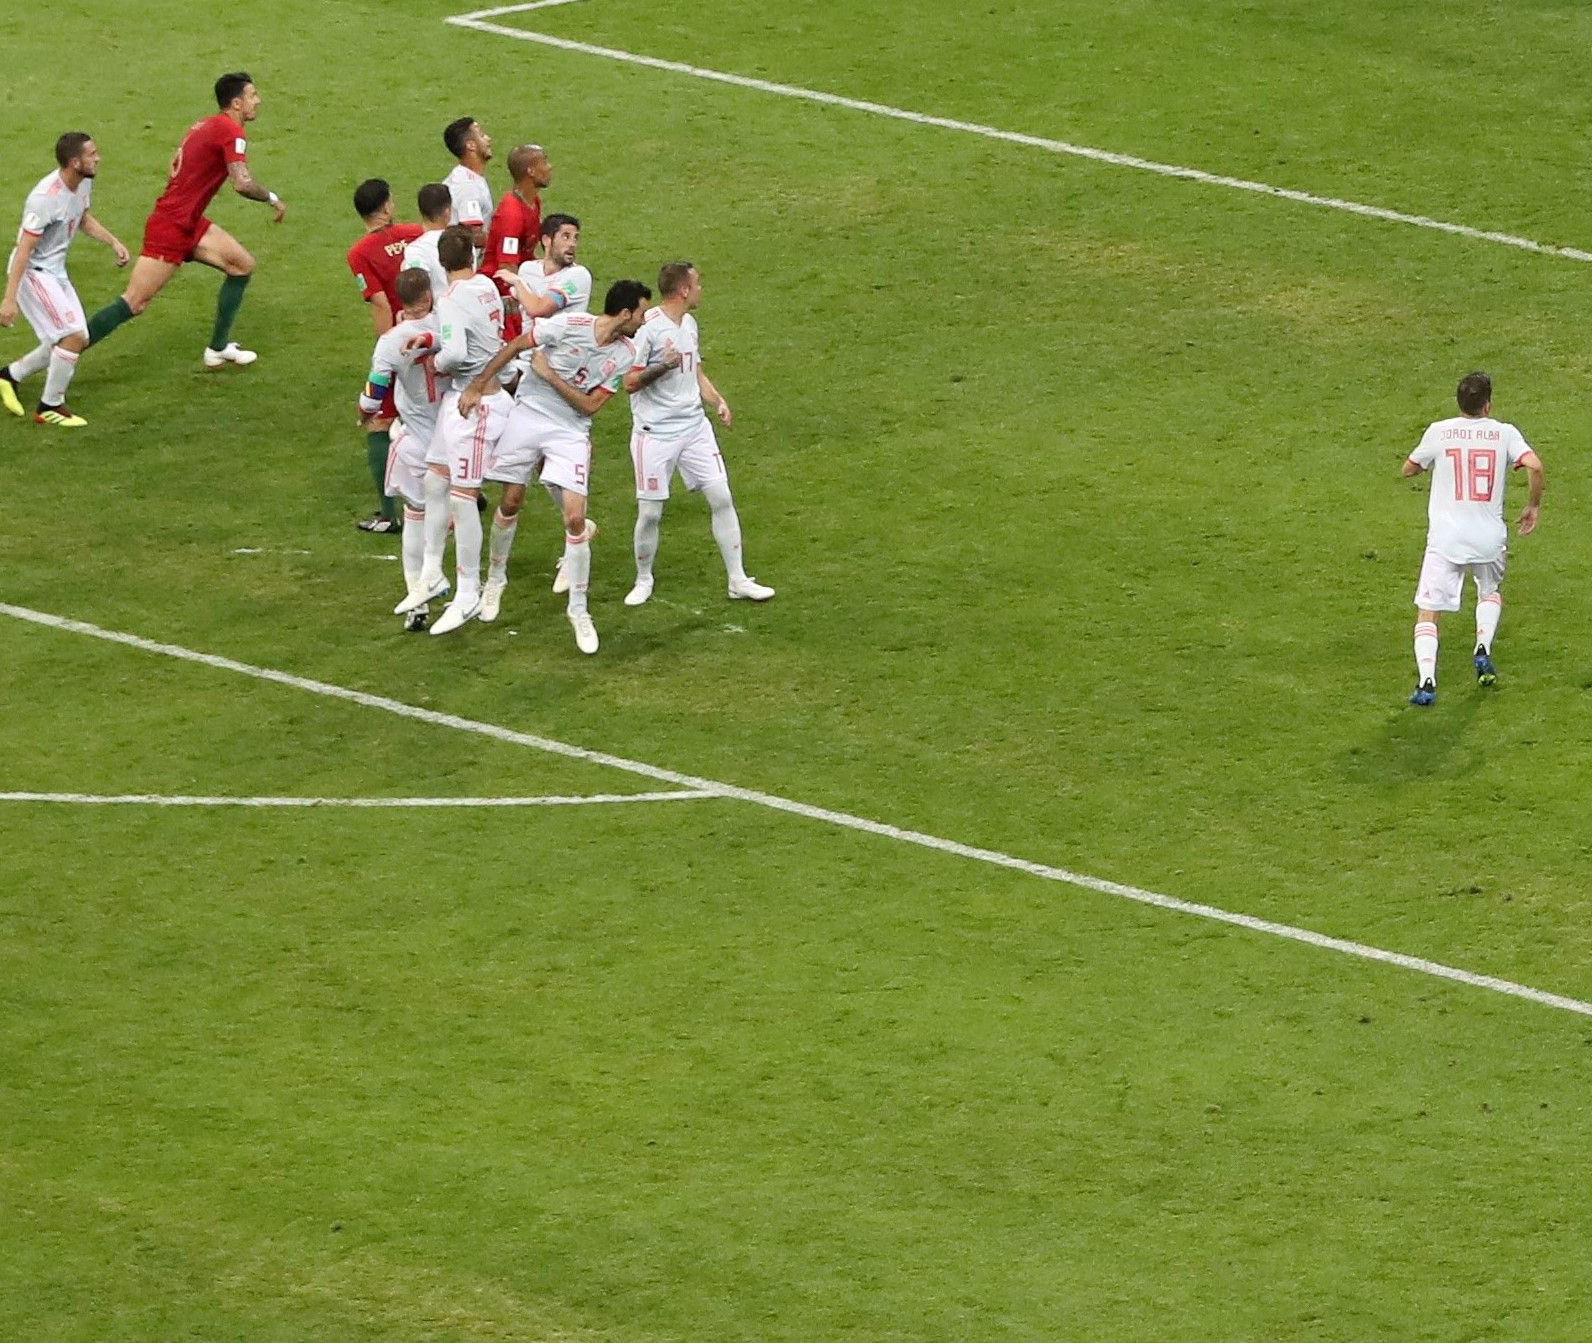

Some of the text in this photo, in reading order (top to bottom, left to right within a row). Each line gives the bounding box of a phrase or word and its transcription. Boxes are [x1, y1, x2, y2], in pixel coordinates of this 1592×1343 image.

[574, 366, 590, 385] 5
[1476, 429, 1501, 441] ALBA
[458, 457, 469, 480] 3
[575, 463, 586, 486] 5
[1445, 447, 1497, 503] 18
